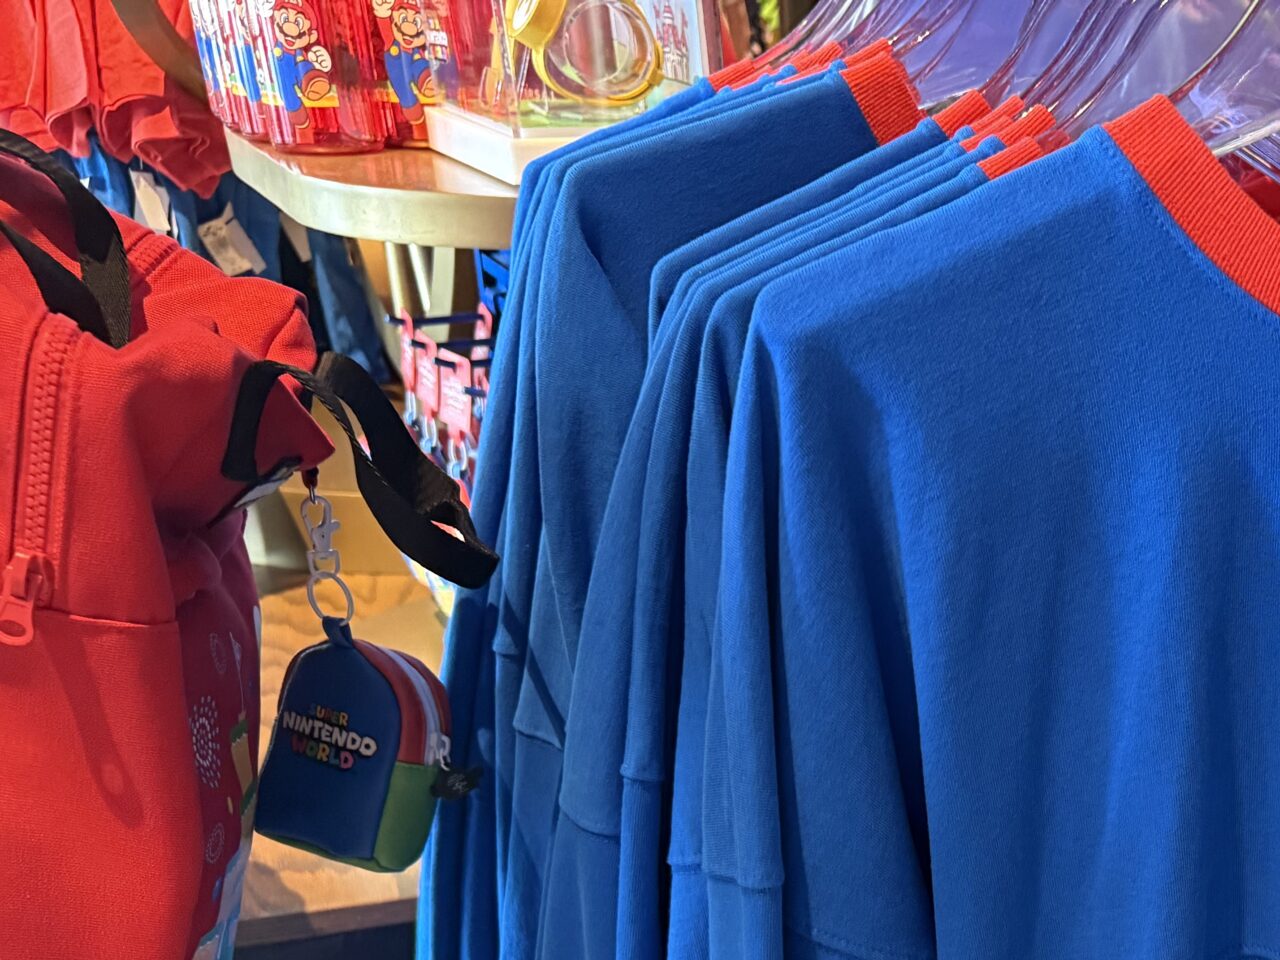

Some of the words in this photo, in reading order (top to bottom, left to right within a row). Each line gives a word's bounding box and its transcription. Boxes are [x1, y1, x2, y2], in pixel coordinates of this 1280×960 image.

[308, 703, 348, 727] SUPER
[282, 711, 378, 757] NINTENDO
[291, 735, 354, 769] WORLD
